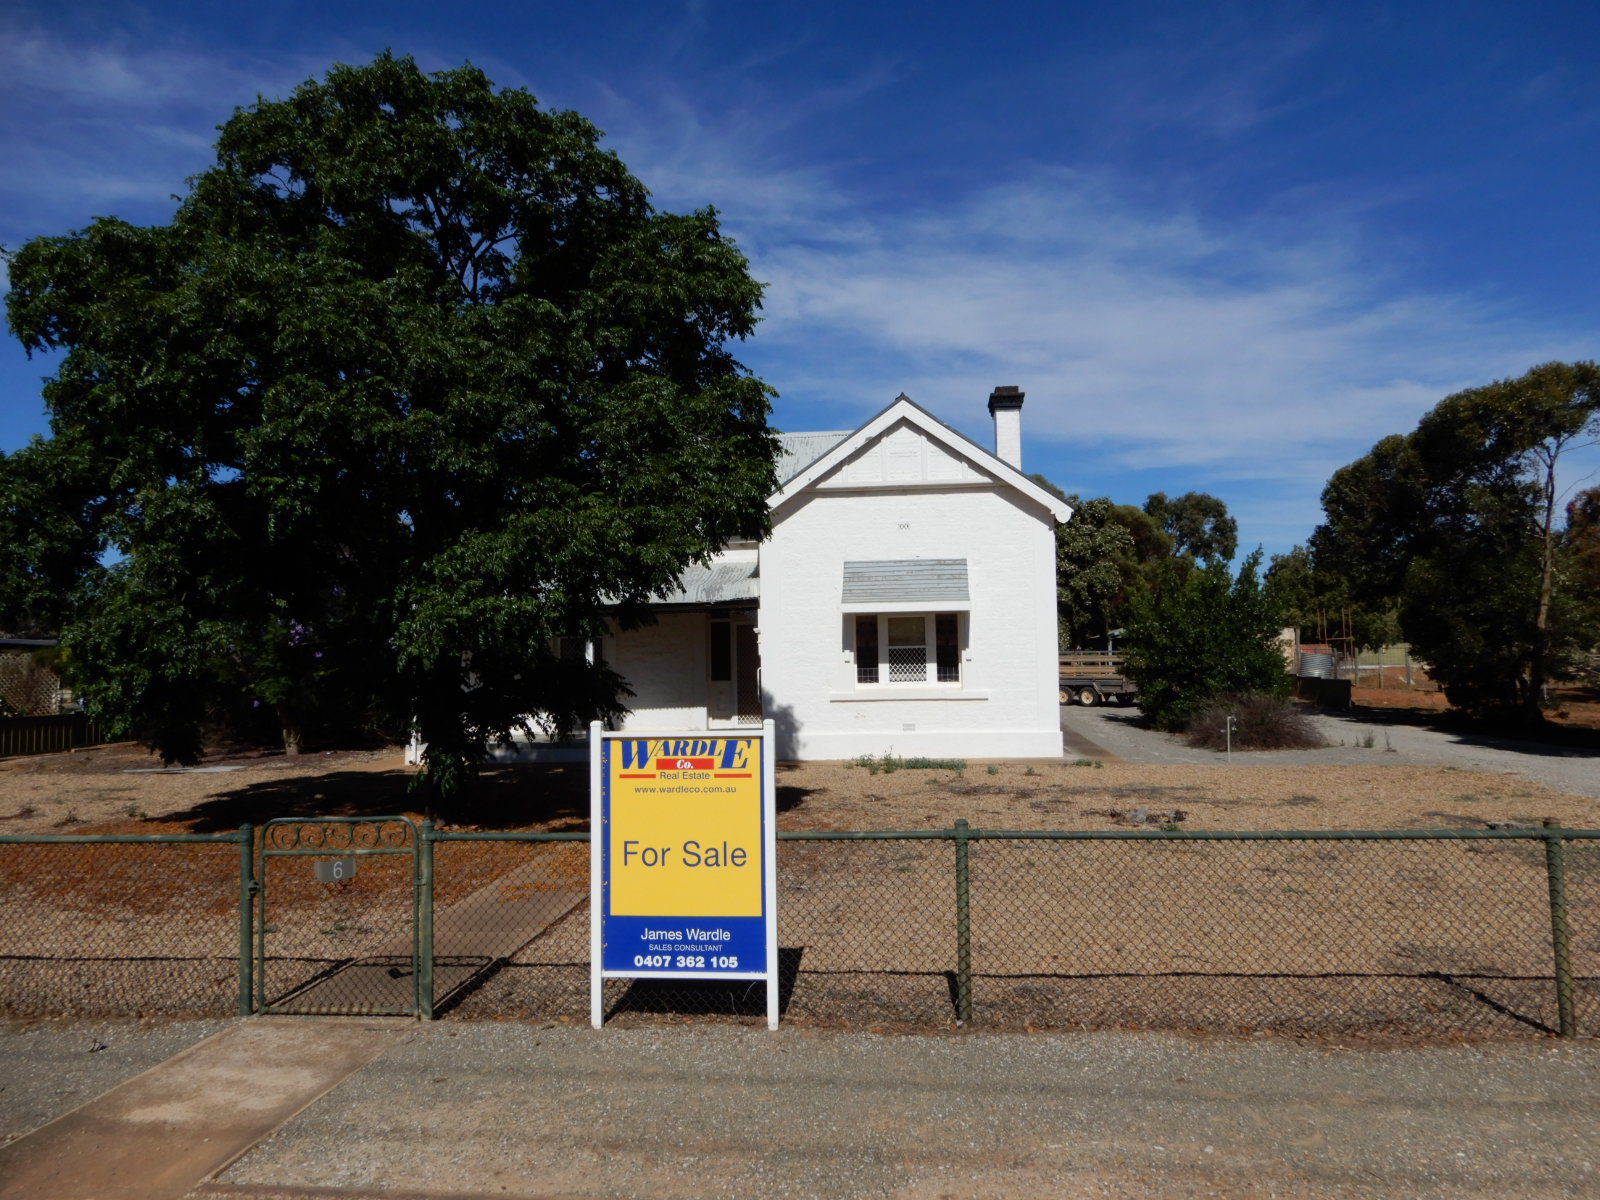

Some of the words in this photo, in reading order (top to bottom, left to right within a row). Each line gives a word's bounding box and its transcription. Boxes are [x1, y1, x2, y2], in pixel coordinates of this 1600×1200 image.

[620, 740, 751, 769] WARDLE
[676, 759, 694, 769] Co.
[660, 771, 679, 780] Real
[682, 771, 711, 780] Estate
[623, 840, 671, 867] For
[682, 840, 747, 867] Sale
[333, 861, 343, 878] 6
[641, 928, 683, 941] James
[686, 928, 731, 941] Wardle
[674, 944, 723, 952] CONSULTANT
[634, 955, 671, 967] 0407
[676, 955, 705, 967] 362
[710, 955, 738, 967] 105
